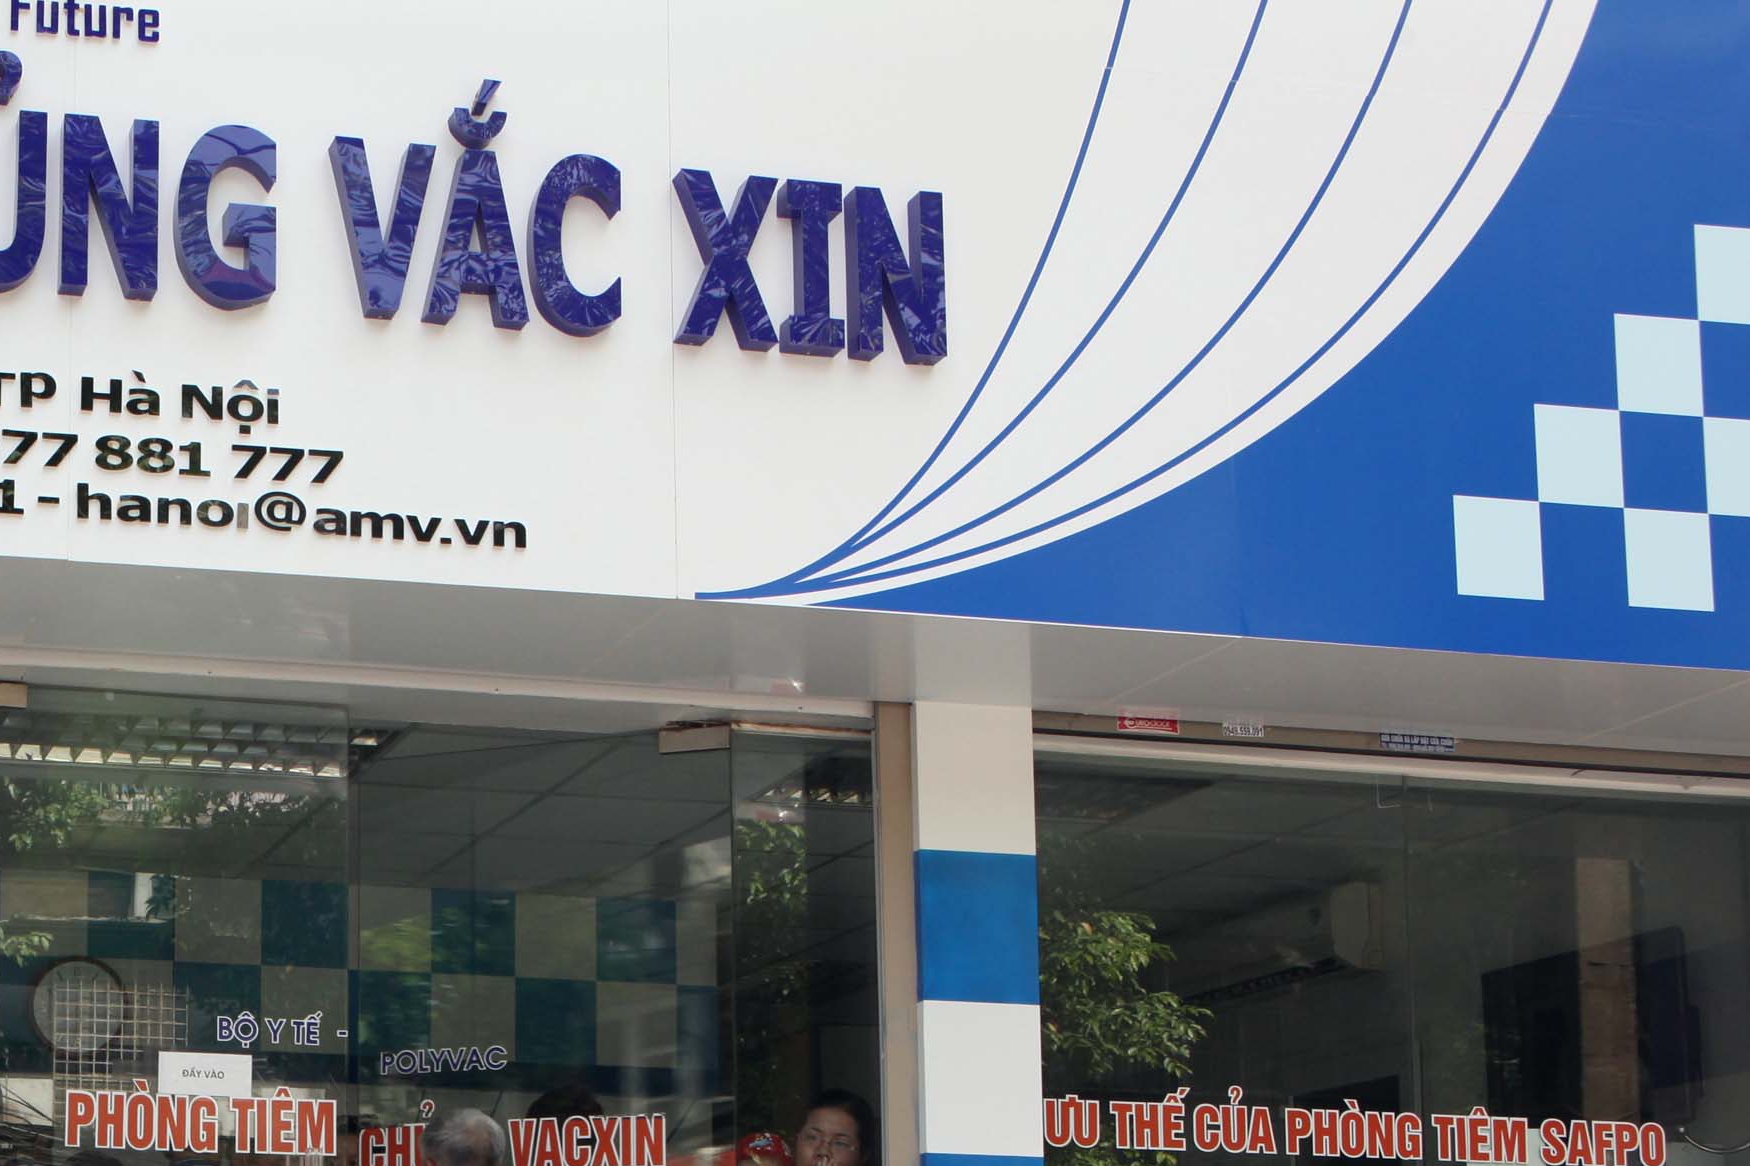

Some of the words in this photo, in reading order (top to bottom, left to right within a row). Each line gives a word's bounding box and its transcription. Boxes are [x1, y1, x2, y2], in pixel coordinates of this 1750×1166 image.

[328, 77, 623, 339] VẮC
[673, 165, 947, 366] XIN
[81, 371, 160, 416] Hà
[182, 380, 278, 434] Nội
[95, 435, 210, 476] 881
[232, 445, 343, 483] 777
[216, 1010, 260, 1049] BỘ
[264, 1017, 287, 1044] Y
[290, 1010, 324, 1046] TẾ
[379, 1045, 508, 1076] POLYVAC
[65, 1078, 219, 1154] PHÒNG
[229, 1086, 337, 1157] TIÊM
[1044, 1094, 1101, 1149] ƯU
[1109, 1087, 1191, 1151] THẾ
[1193, 1084, 1276, 1156] CỦA
[1285, 1098, 1423, 1160] PHÒNG
[1431, 1106, 1529, 1165] TIÊM
